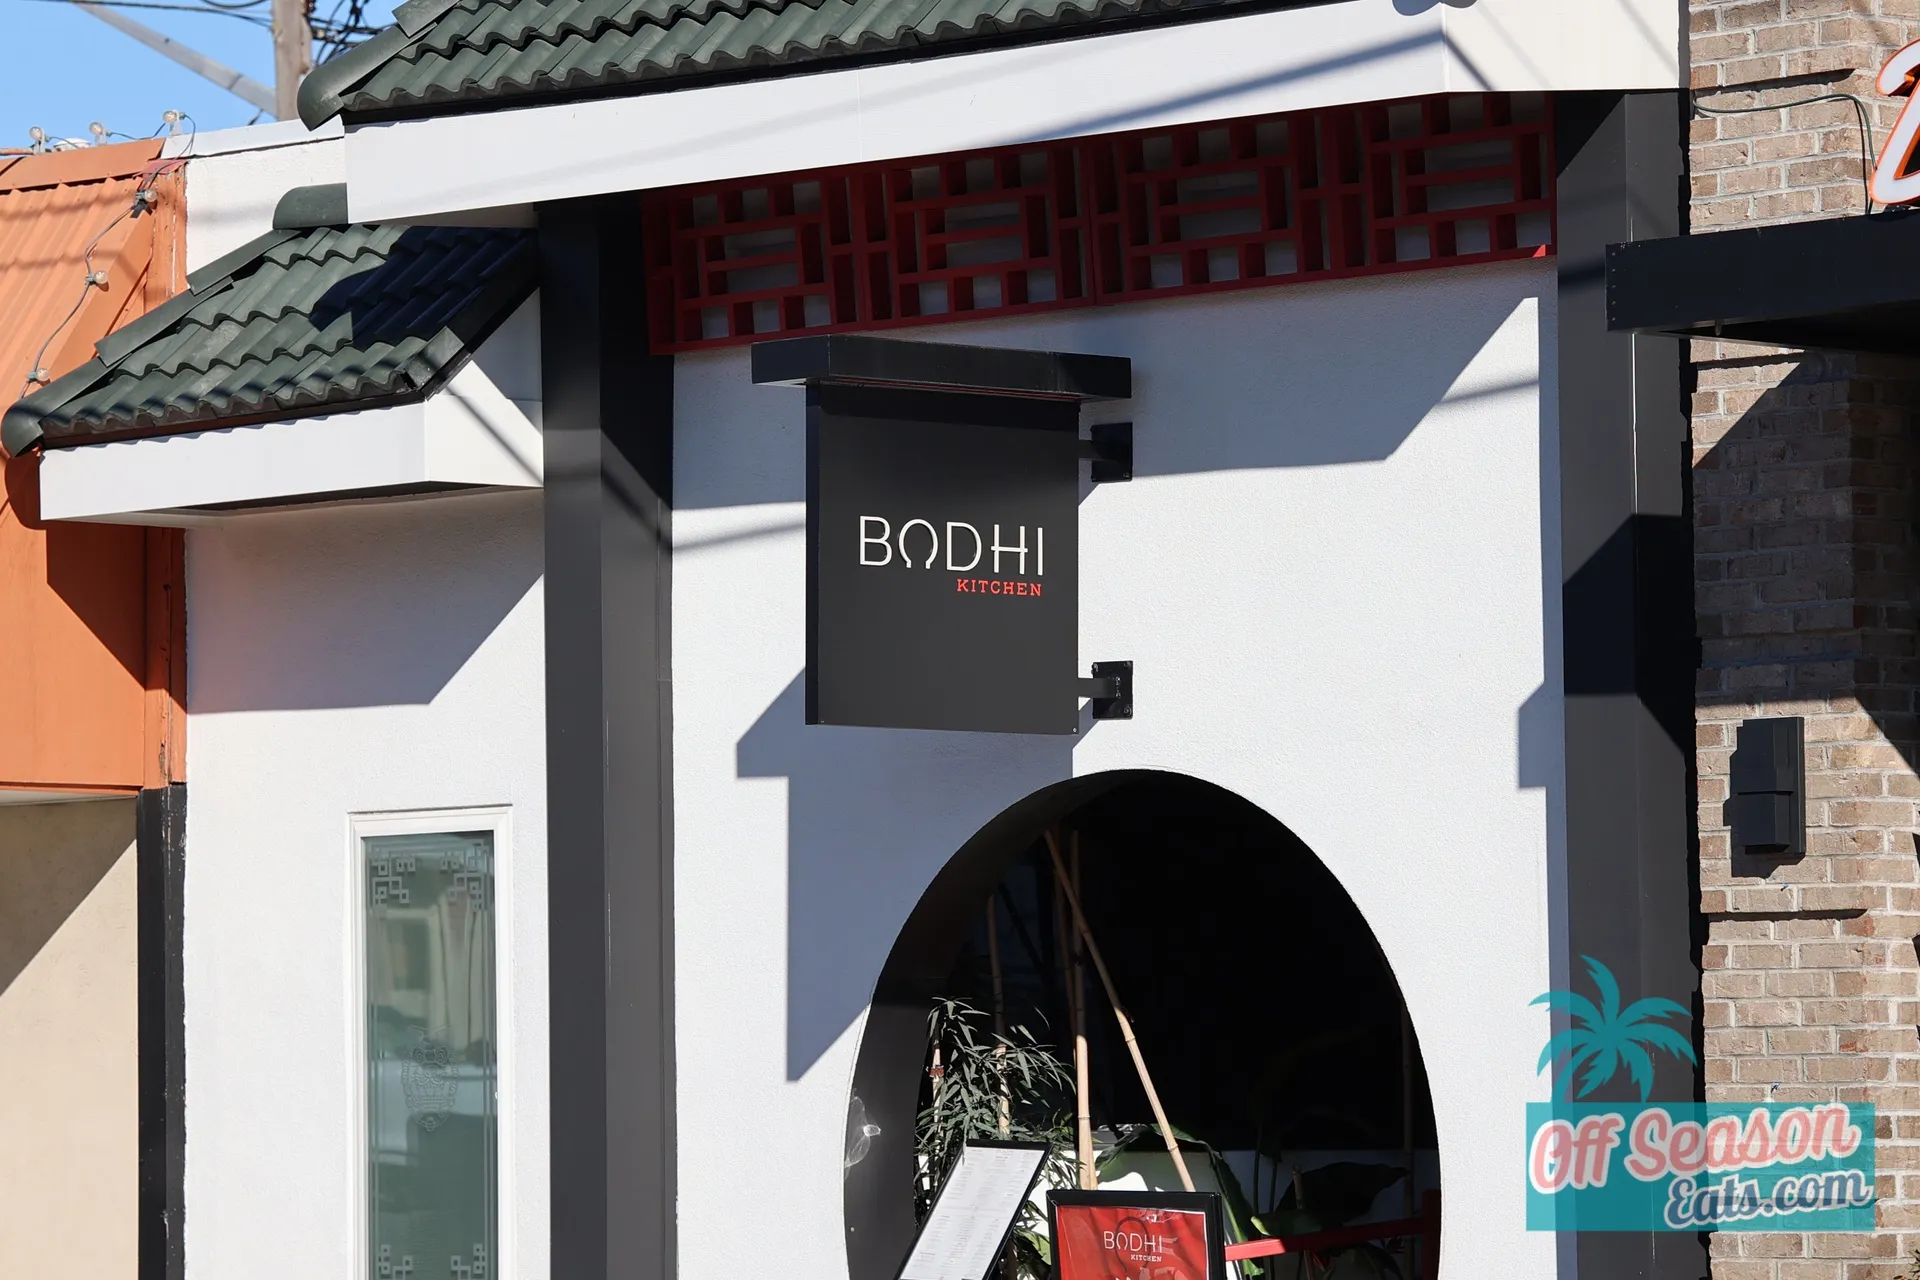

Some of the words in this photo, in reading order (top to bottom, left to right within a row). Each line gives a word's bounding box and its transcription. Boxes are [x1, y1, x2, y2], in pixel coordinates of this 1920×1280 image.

[859, 515, 1044, 576] BODHI
[956, 578, 1042, 597] KITCHEN
[1103, 1231, 1162, 1253] BODHI
[1130, 1254, 1162, 1262] KITCHEN
